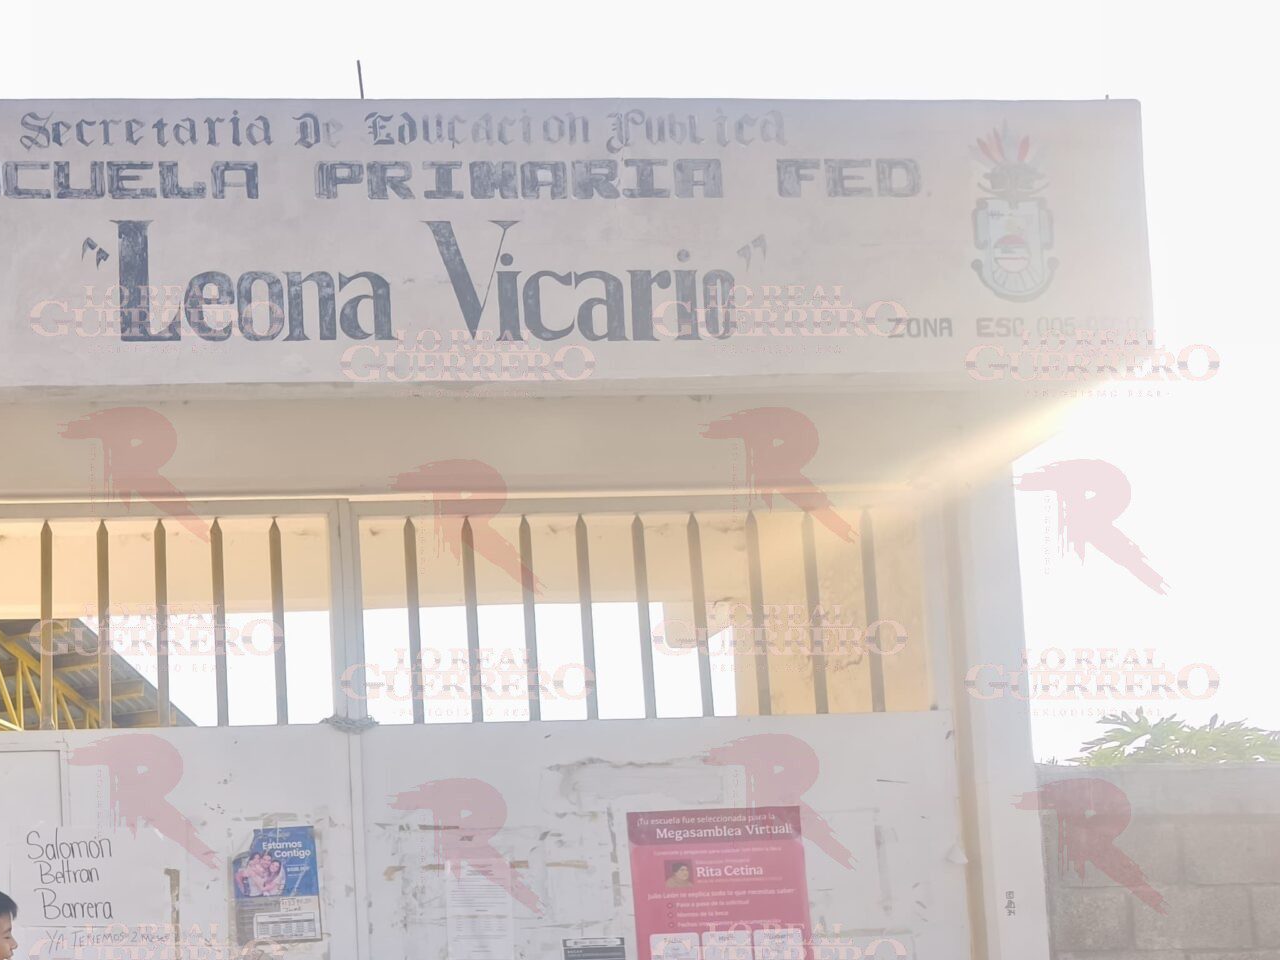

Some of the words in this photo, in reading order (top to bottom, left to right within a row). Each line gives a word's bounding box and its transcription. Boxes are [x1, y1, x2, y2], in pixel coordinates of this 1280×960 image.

[19, 108, 274, 151] Secretaria
[291, 108, 344, 150] De
[314, 158, 725, 200] PRIMARIA
[887, 317, 953, 339] ZONA
[650, 816, 680, 825] escuela
[682, 815, 695, 824] fue
[697, 814, 746, 823] seleccionada
[656, 826, 742, 840] Megasamblea
[745, 822, 793, 835] Virtual!
[262, 840, 302, 850] Estamos
[274, 848, 311, 858] Contigo
[33, 859, 100, 884] Beltran
[696, 866, 721, 877] Rita
[724, 865, 763, 876] Cetina
[33, 887, 114, 920] Barrera
